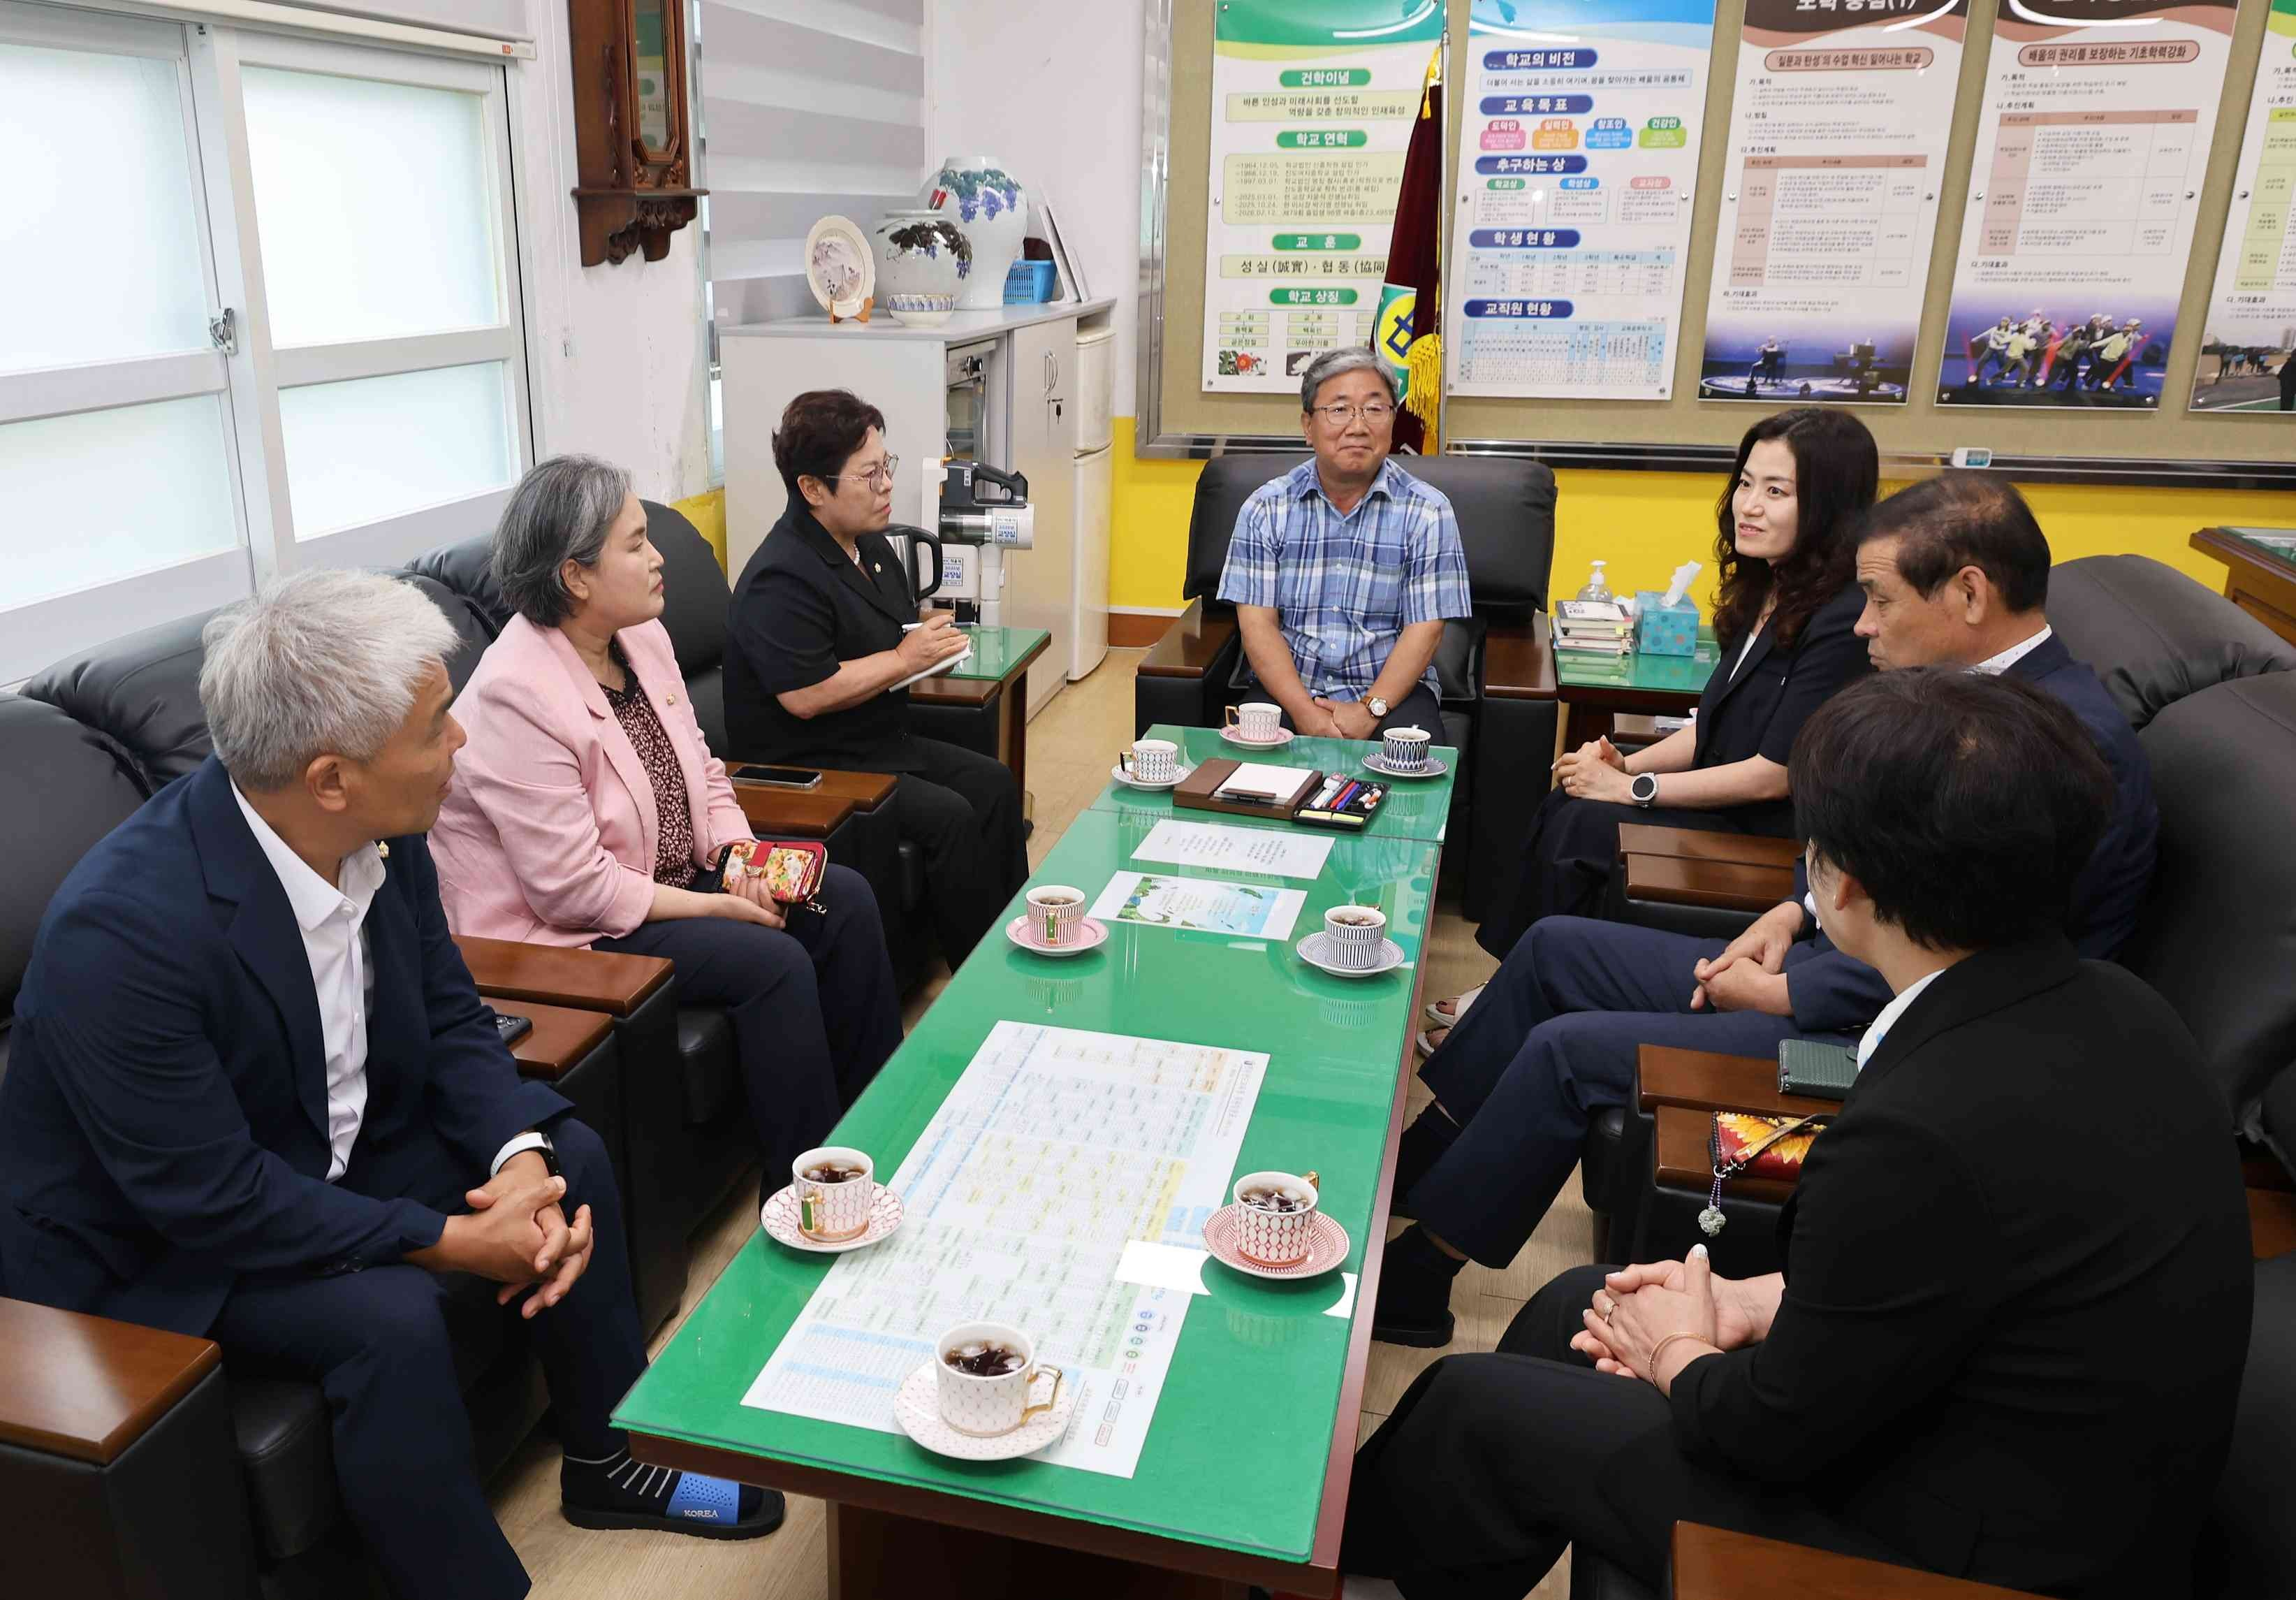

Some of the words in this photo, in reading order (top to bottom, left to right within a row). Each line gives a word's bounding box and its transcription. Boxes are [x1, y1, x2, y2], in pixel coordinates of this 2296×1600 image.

[1506, 52, 1544, 67] 학교의
[1549, 51, 1575, 66] 비전
[2028, 50, 2056, 61] 배움의
[2059, 48, 2086, 61] 권리를
[2089, 47, 2126, 60] 보장하는
[2129, 44, 2186, 59] 기초학력강화
[1833, 54, 1849, 66] 수업
[1905, 53, 1921, 64] 학교
[1301, 71, 1350, 85] 건학이념
[1262, 97, 1286, 106] 인성과
[1289, 96, 1330, 106] 미래사회를
[1652, 118, 1677, 128] 건강인
[1296, 133, 1320, 146] 학교
[1325, 132, 1348, 146] 연혁
[1497, 158, 1548, 173] 추구하는
[1553, 157, 1565, 172] 상
[1288, 291, 1312, 303] 학교
[1315, 291, 1339, 303] 상징
[1486, 302, 1523, 315] 교직원
[1527, 302, 1553, 315] 현황
